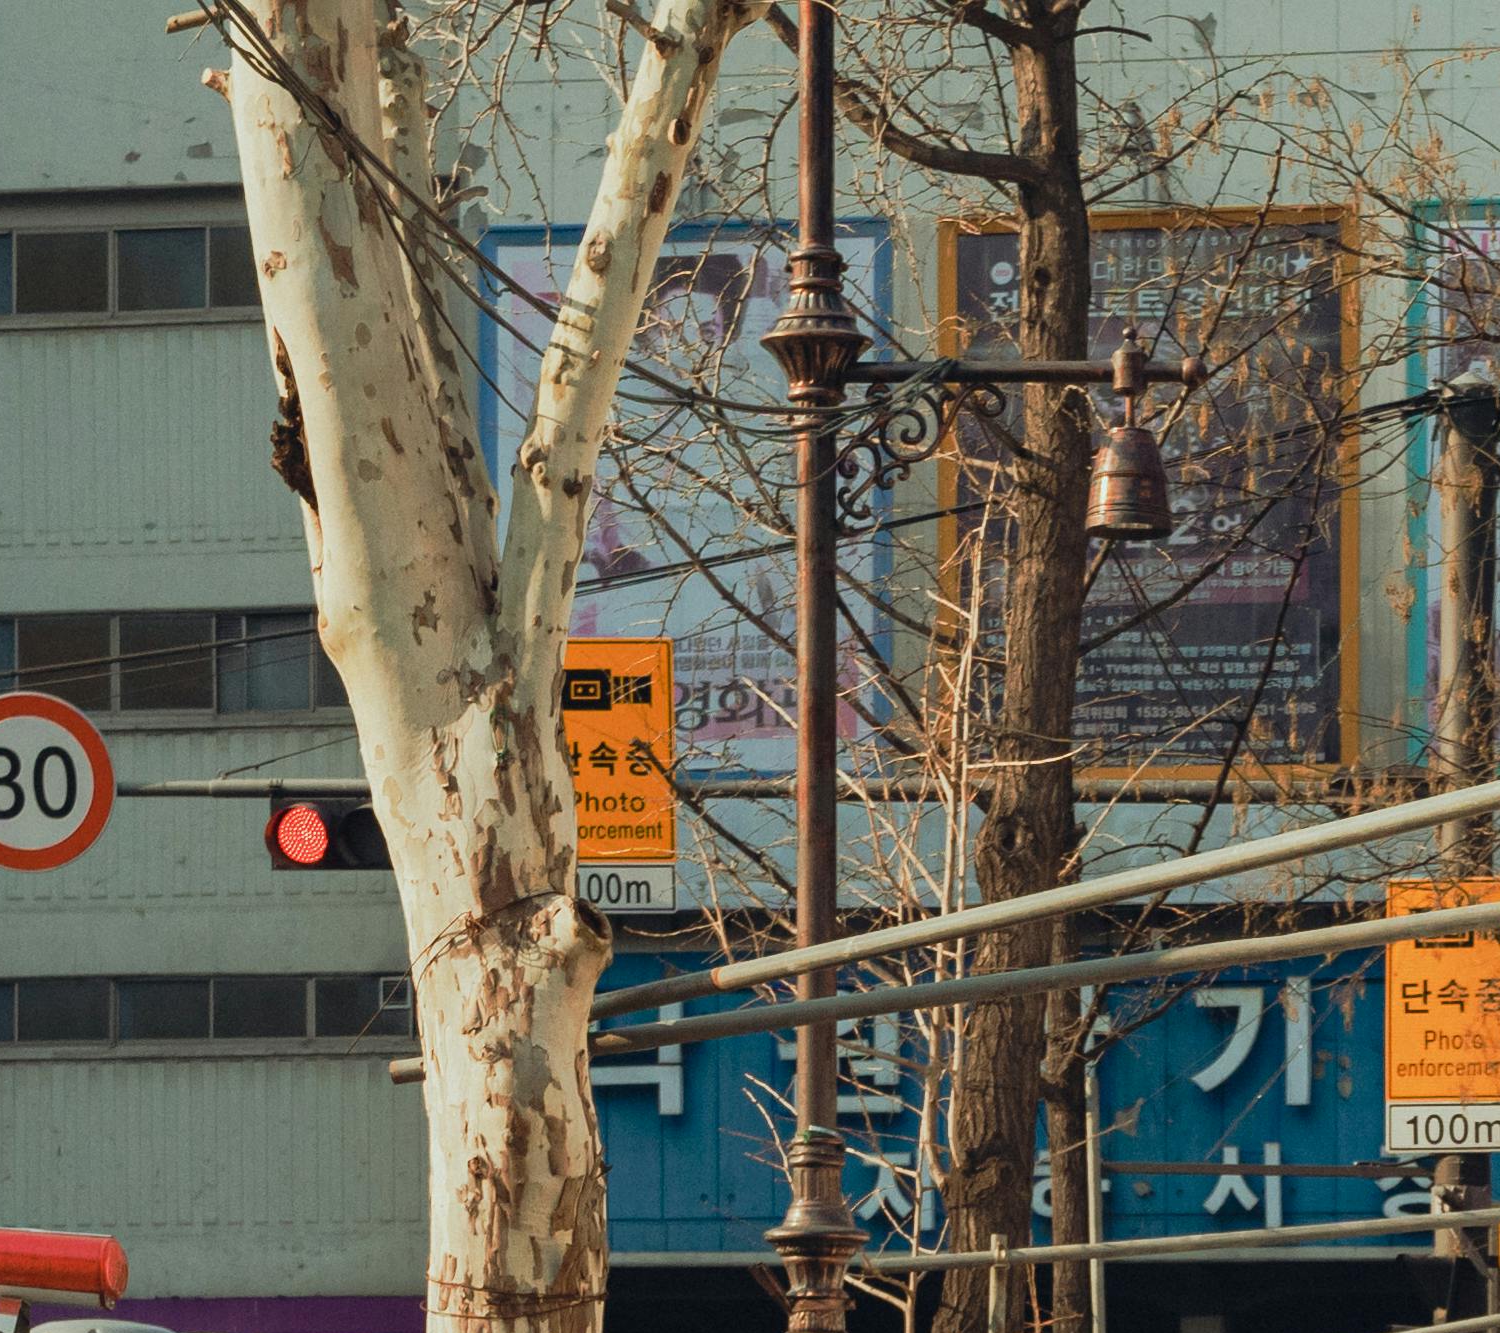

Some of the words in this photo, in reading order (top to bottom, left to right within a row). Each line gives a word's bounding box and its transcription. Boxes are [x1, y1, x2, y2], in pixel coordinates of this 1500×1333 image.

[577, 821, 663, 840] orcement
[587, 872, 652, 905] 00m
[1424, 1029, 1485, 1051] Photo
